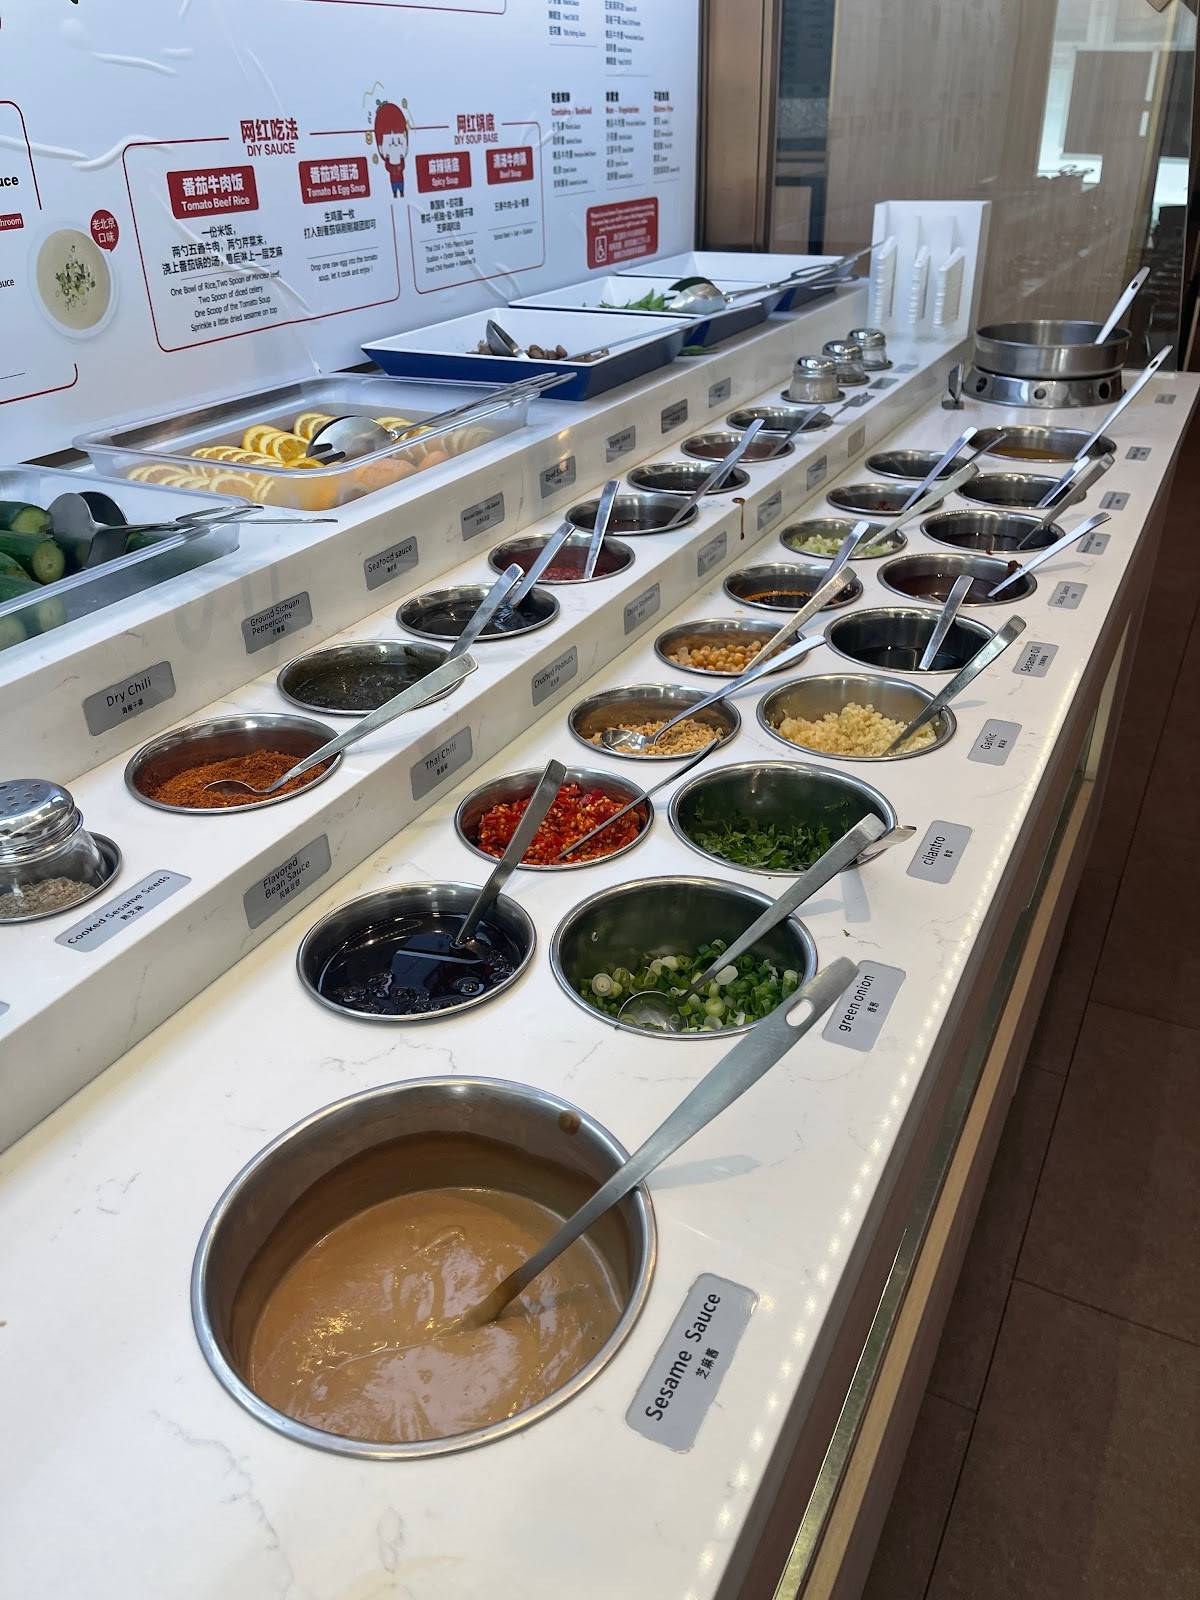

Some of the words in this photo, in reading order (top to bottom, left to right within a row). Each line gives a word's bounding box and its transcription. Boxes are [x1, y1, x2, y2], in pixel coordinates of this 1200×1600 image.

[240, 117, 298, 144] 网红吃法
[247, 144, 262, 156] DIY
[264, 142, 296, 156] SAUCE
[182, 172, 244, 197] 番茄牛肉饭
[181, 199, 213, 212] Tomato
[213, 196, 232, 210] Beef
[232, 195, 250, 206] Rice
[92, 218, 116, 232] 老北京
[98, 231, 116, 244] 口味
[170, 288, 182, 296] One
[184, 285, 196, 294] Bowl
[198, 284, 204, 292] of
[229, 276, 246, 286] Spoon
[198, 296, 210, 304] Two
[211, 292, 228, 302] Spoon
[194, 310, 206, 318] One
[206, 306, 222, 316] Scoop
[224, 304, 229, 312] of
[368, 552, 395, 574] Seafood
[395, 544, 412, 559] sauce
[250, 609, 274, 627] Ground
[276, 600, 300, 615] Sichuan
[252, 612, 292, 637] Peppercorns
[106, 691, 125, 707] Dry
[128, 676, 152, 696] Chili
[922, 836, 946, 866] cilantro
[263, 856, 298, 890] Flavored
[265, 880, 286, 900] Bean
[287, 860, 310, 882] Sauce
[68, 918, 107, 944] Cooked
[106, 894, 143, 919] Sesame
[141, 875, 170, 894] Seeds
[838, 1002, 861, 1033] green
[854, 975, 875, 1002] onion
[645, 1350, 693, 1422] Sesame
[685, 1294, 720, 1343] Sauce
[696, 1347, 720, 1380] 芝麻酱
